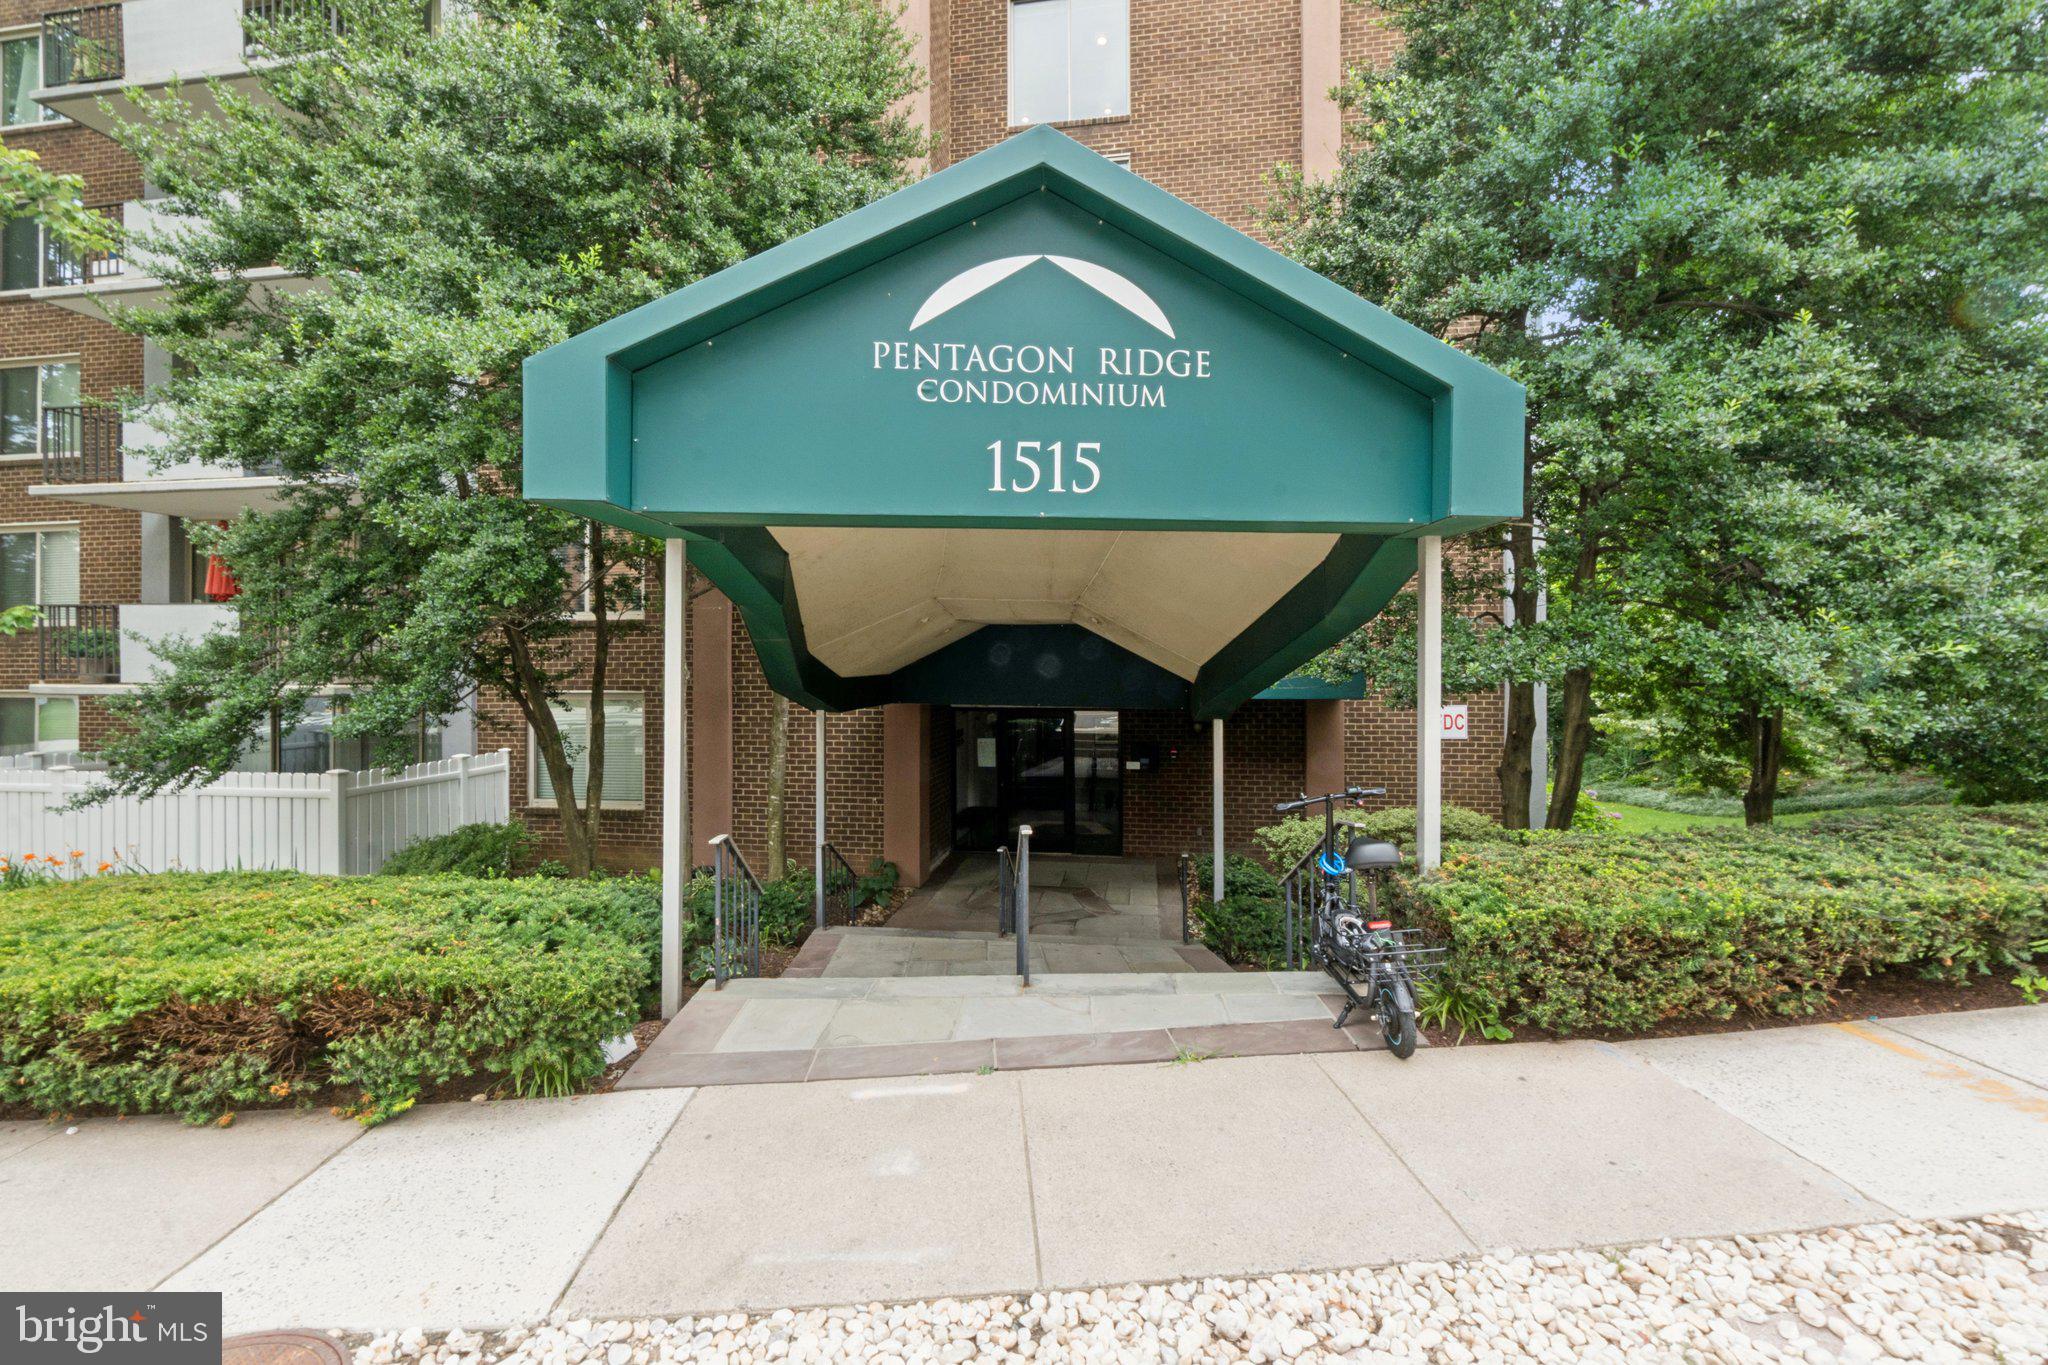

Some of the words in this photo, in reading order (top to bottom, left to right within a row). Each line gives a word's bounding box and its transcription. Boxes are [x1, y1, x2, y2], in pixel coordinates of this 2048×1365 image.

[873, 341, 1074, 374] PENTAGON
[1100, 347, 1211, 378] RIDGE
[917, 378, 1167, 408] CONDOMINIUM
[986, 439, 1101, 494] 1515
[1440, 713, 1465, 731] DC
